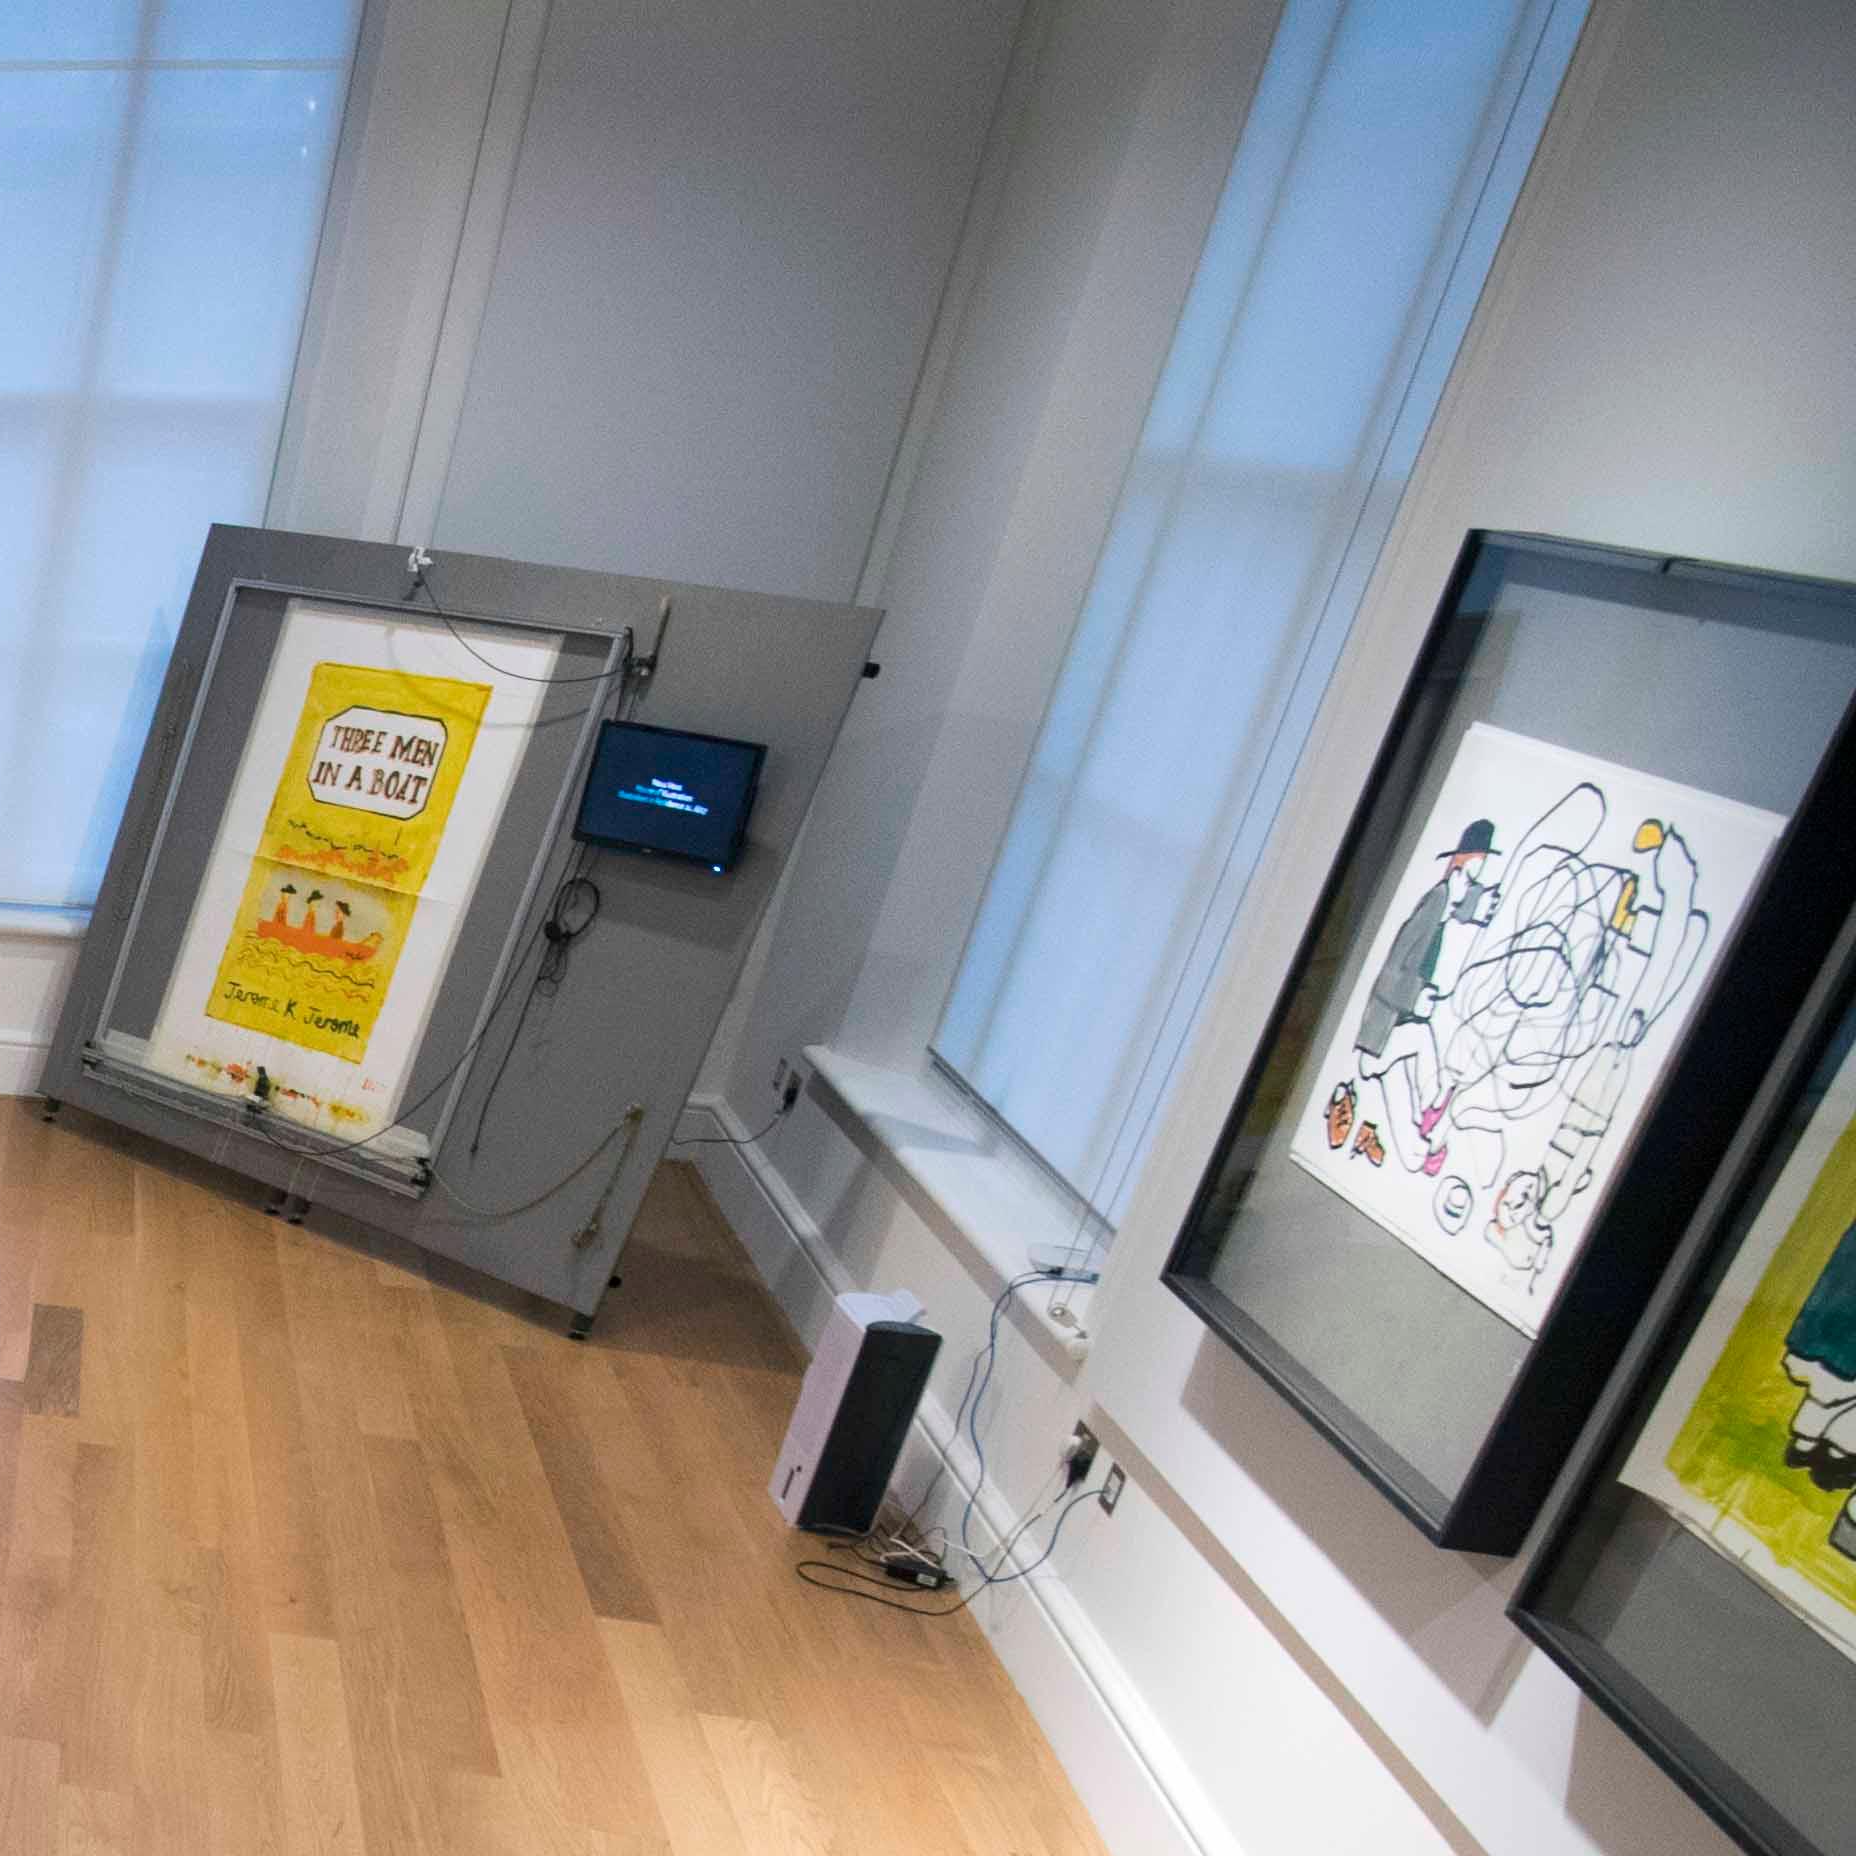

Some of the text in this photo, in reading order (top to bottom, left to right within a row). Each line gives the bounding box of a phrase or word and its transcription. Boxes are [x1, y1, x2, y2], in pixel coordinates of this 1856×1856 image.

[328, 724, 440, 768] THREE MEN
[312, 761, 428, 805] IN A BOAT
[284, 998, 298, 1020] K
[304, 1006, 361, 1039] Jerome
